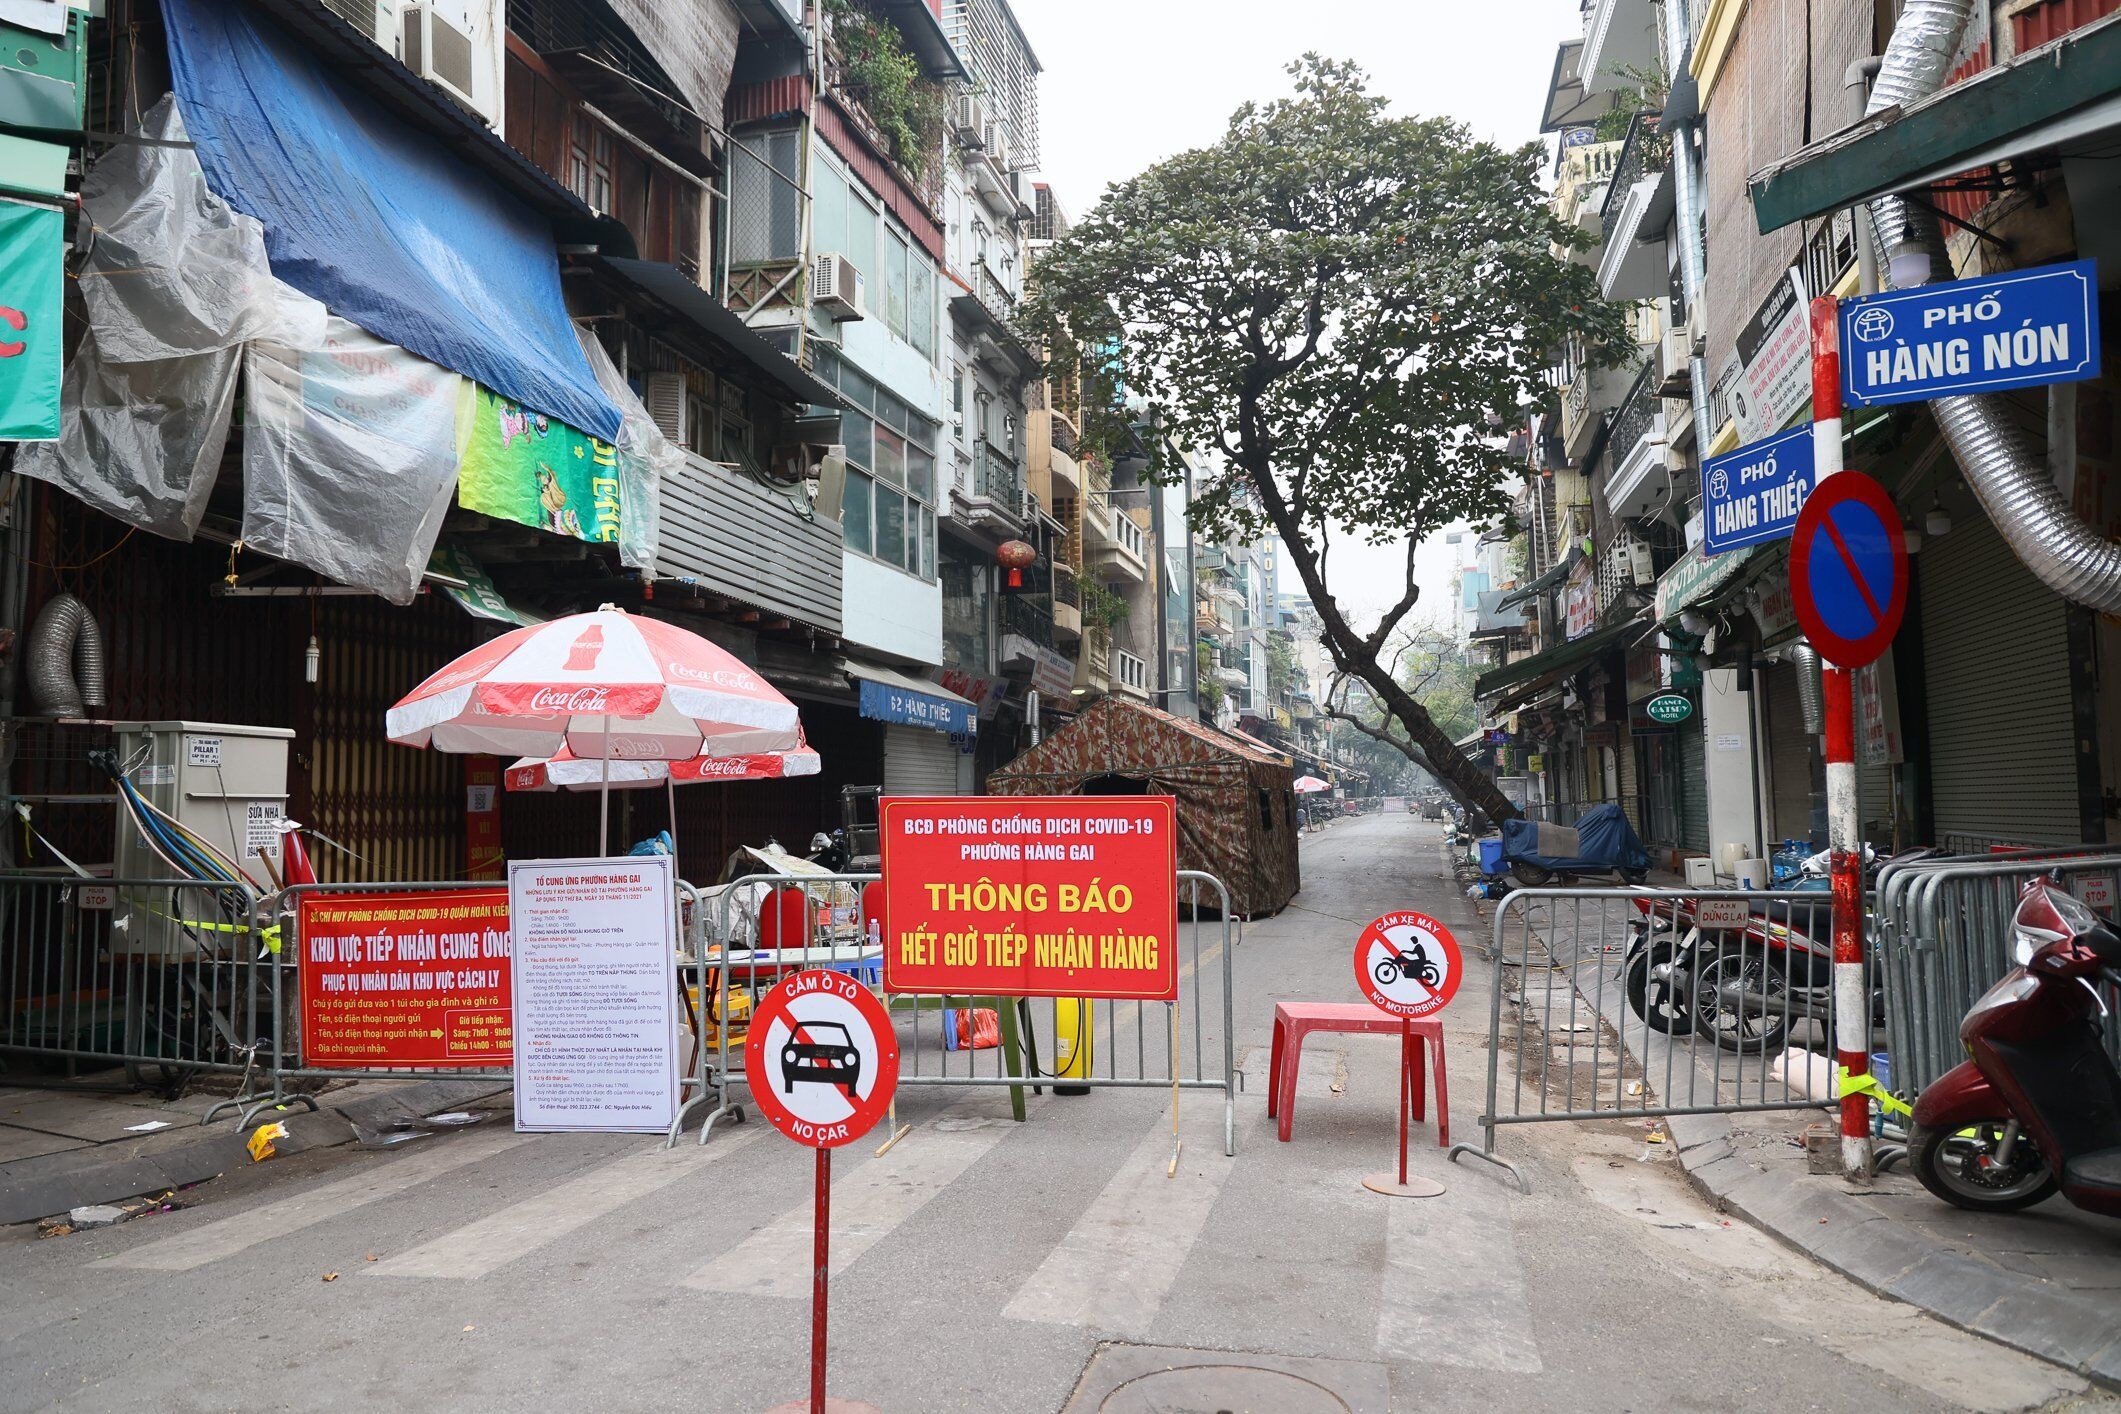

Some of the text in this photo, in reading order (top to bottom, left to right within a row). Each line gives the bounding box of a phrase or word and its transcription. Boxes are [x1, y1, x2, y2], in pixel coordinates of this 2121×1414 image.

[1924, 290, 2002, 328] PHỐ
[1867, 339, 1969, 386] HÀNG
[1983, 319, 2068, 370] NÓN
[1741, 449, 1776, 484] PHỐ
[1715, 494, 1757, 536] HÀNG
[1761, 470, 1807, 522] THIẾC
[1263, 540, 1274, 624] HOTEL
[891, 695, 902, 713] 62
[905, 696, 926, 717] HÀNG
[248, 802, 262, 818] SỬA
[904, 813, 1153, 838] BCĐ PHÒNG CHỐNG DỊCH COVID-19
[961, 841, 1094, 861] PHƯỜNG HÀNG GAI
[546, 877, 564, 886] CUNG
[566, 876, 579, 885] ỨNG
[580, 875, 607, 885] PHƯỜNG
[609, 875, 628, 884] HÀNG
[629, 874, 640, 883] GAI
[924, 876, 1133, 913] THÔNG BÁO
[2086, 890, 2107, 902] STOP
[332, 910, 346, 922] HUY
[347, 907, 371, 922] PHÒNG
[373, 906, 398, 921] CHỐNG
[399, 909, 415, 923] DỊCH
[416, 907, 448, 920] COVID-19
[449, 906, 470, 920] QUẬN
[470, 906, 490, 917] HOÀN
[1376, 915, 1440, 933] CẤM XE MÁY
[310, 937, 334, 963] KHU
[338, 934, 362, 968] VỰC
[365, 927, 394, 962] TIẾP
[398, 928, 436, 966] NHẬN
[440, 933, 479, 960] CUNG
[482, 926, 511, 959] ỨNG
[901, 922, 1158, 976] HẾT GIỜ TIẾP NHẬN HÀNG
[322, 968, 499, 996] PHỤC VỤ NHÂN DÂN KHU VỰC CÁCH LY
[786, 976, 817, 997] CẤM
[838, 980, 858, 1000] TÔ
[313, 999, 326, 1007] Chú
[357, 998, 373, 1007] đưa
[374, 998, 388, 1007] vào
[397, 997, 408, 1007] túi
[409, 998, 425, 1007] cho
[426, 998, 439, 1008] gia
[441, 997, 460, 1006] đình
[462, 997, 472, 1006] và
[474, 997, 487, 1007] ghi
[489, 996, 498, 1005] rõ
[1371, 991, 1444, 1014] NO MOTORBIKE
[318, 1014, 332, 1024] Tên,
[344, 1014, 361, 1024] điện
[363, 1014, 382, 1024] thoại
[384, 1013, 405, 1025] người
[408, 1013, 421, 1025] gửi
[486, 1015, 504, 1024] nhận:
[319, 1029, 332, 1038] Tên,
[344, 1029, 361, 1039] điện
[363, 1029, 382, 1039] thoại
[384, 1028, 406, 1039] người
[408, 1028, 428, 1039] nhận
[453, 1028, 511, 1038] Sáng: 7h00 9h00
[318, 1044, 330, 1054] Địa
[344, 1043, 365, 1054] người
[367, 1043, 388, 1054] nhận.
[450, 1040, 468, 1050] Chiều
[469, 1041, 489, 1050] 14h00
[792, 1120, 849, 1141] NO CAR
